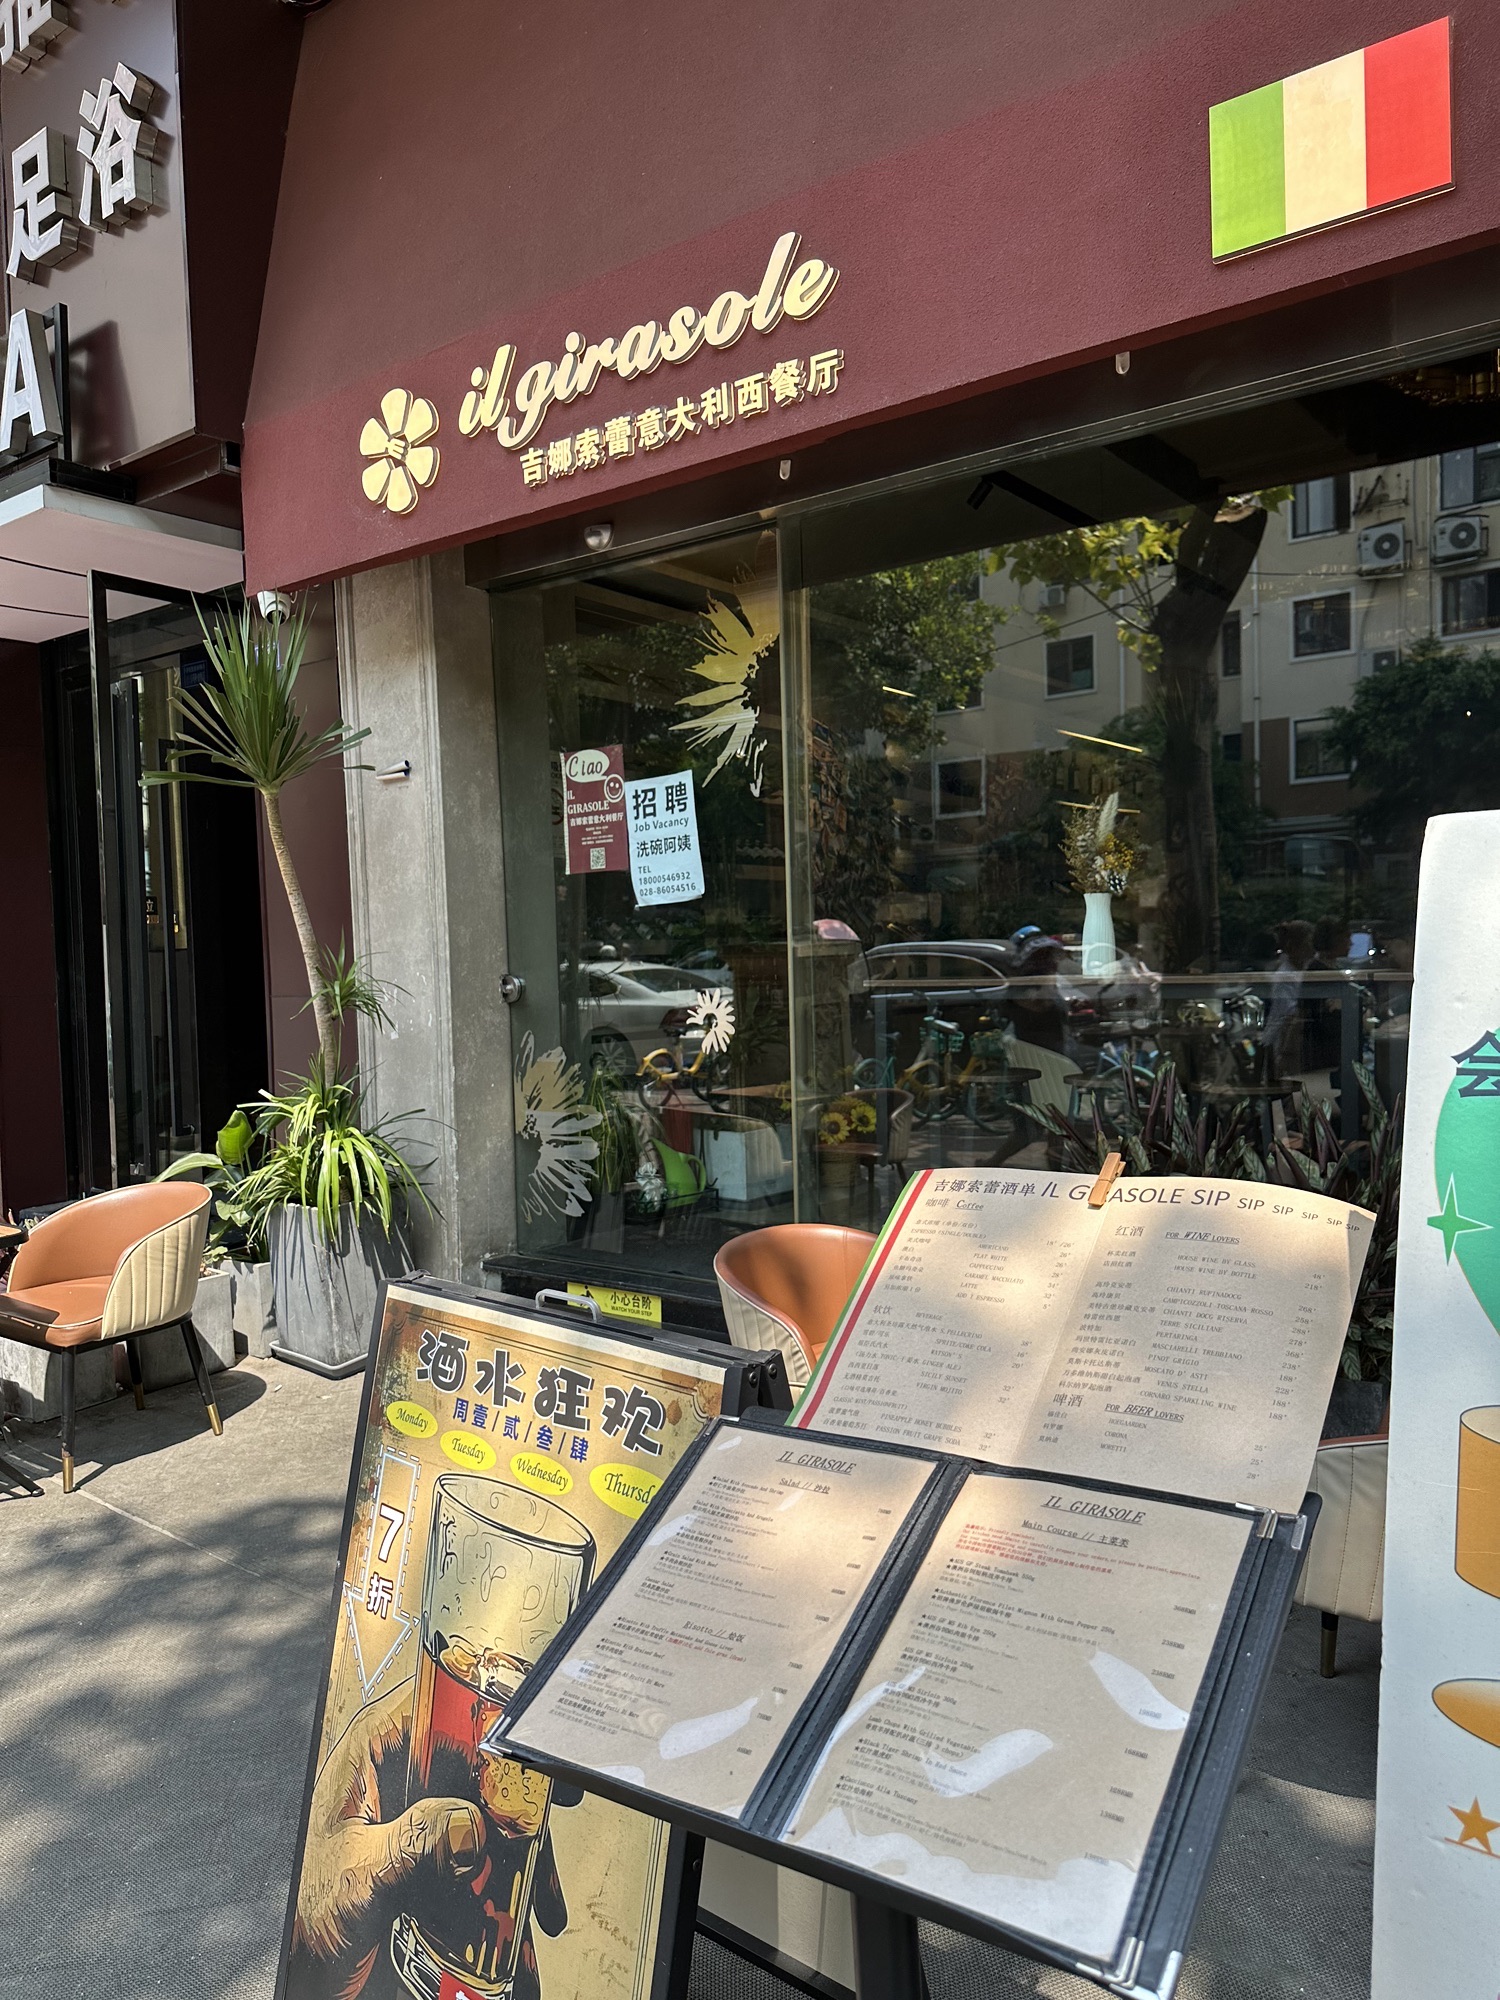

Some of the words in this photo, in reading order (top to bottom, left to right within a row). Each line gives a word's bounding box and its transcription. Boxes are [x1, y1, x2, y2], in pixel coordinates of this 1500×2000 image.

[7, 62, 143, 277] 足浴
[498, 231, 840, 449] girasole
[520, 348, 843, 487] 吉娜索蕾意大利西餐厅
[568, 756, 602, 777] Ciao
[567, 790, 575, 800] IL
[632, 782, 688, 820] 招聘
[568, 801, 610, 814] GIRASOLE
[634, 820, 650, 832] Job
[653, 818, 689, 830] Vacancy
[636, 834, 691, 858] 洗碗阿姨
[638, 866, 651, 874] TEL
[639, 872, 691, 885] 18000546932
[640, 883, 696, 896] 028-86054516
[925, 1198, 950, 1208] 咖啡
[956, 1200, 984, 1210] Coffee
[934, 1179, 1036, 1197] 吉娜索蕾酒单
[1041, 1182, 1059, 1198] IL
[1068, 1185, 1185, 1204] GASOLE
[1191, 1190, 1230, 1206] SIP
[1237, 1198, 1264, 1210] SIP
[1272, 1205, 1294, 1215] SIP
[1302, 1212, 1318, 1220] SIP
[1326, 1218, 1342, 1226] SIP
[1115, 1226, 1145, 1236] 红酒
[1184, 1232, 1211, 1241] WINE
[1212, 1236, 1240, 1244] LOVERS
[610, 1292, 652, 1310] 小心台阶
[416, 1330, 667, 1456] 酒水狂欢
[1053, 1393, 1084, 1408] 啤酒
[1105, 1404, 1120, 1412] FOR
[1124, 1404, 1153, 1416] BEER
[1155, 1411, 1184, 1421] LOVERS
[396, 1407, 429, 1432] Monday
[452, 1437, 486, 1464] Tuesday
[780, 1451, 794, 1462] IL
[798, 1454, 856, 1474] GIRASOLE
[516, 1458, 569, 1488] Wednesday
[780, 1478, 800, 1488] Salad
[604, 1472, 655, 1506] Thursd
[1045, 1496, 1062, 1508] IL
[1070, 1501, 1146, 1523] GIRASOLE
[1022, 1520, 1042, 1530] Main
[1047, 1525, 1078, 1538] Course
[1099, 1535, 1130, 1547] 主菜类
[682, 1620, 713, 1635] Risotto
